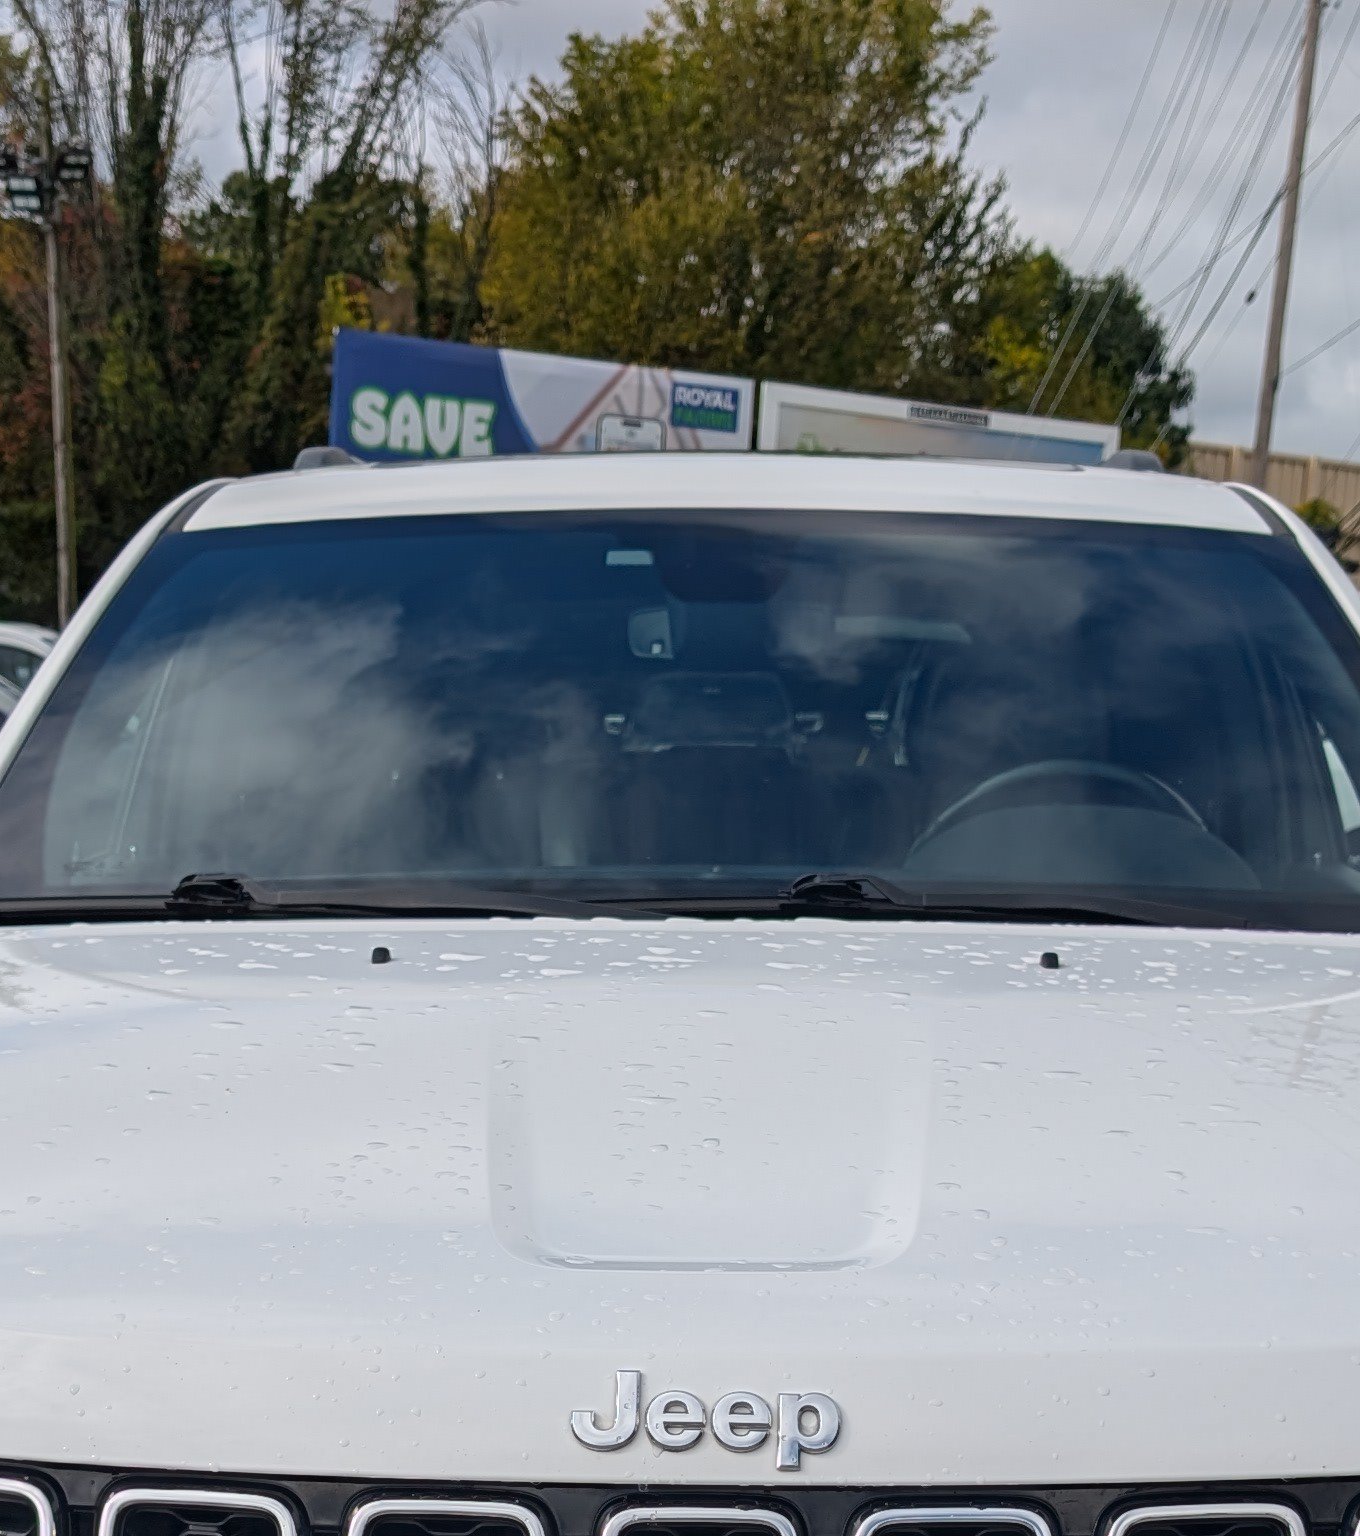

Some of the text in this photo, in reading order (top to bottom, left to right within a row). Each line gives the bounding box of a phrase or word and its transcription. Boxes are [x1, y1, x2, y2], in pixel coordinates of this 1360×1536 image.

[350, 389, 495, 456] SAVE
[674, 385, 736, 412] ROYAL
[570, 1369, 842, 1472] Jeep
